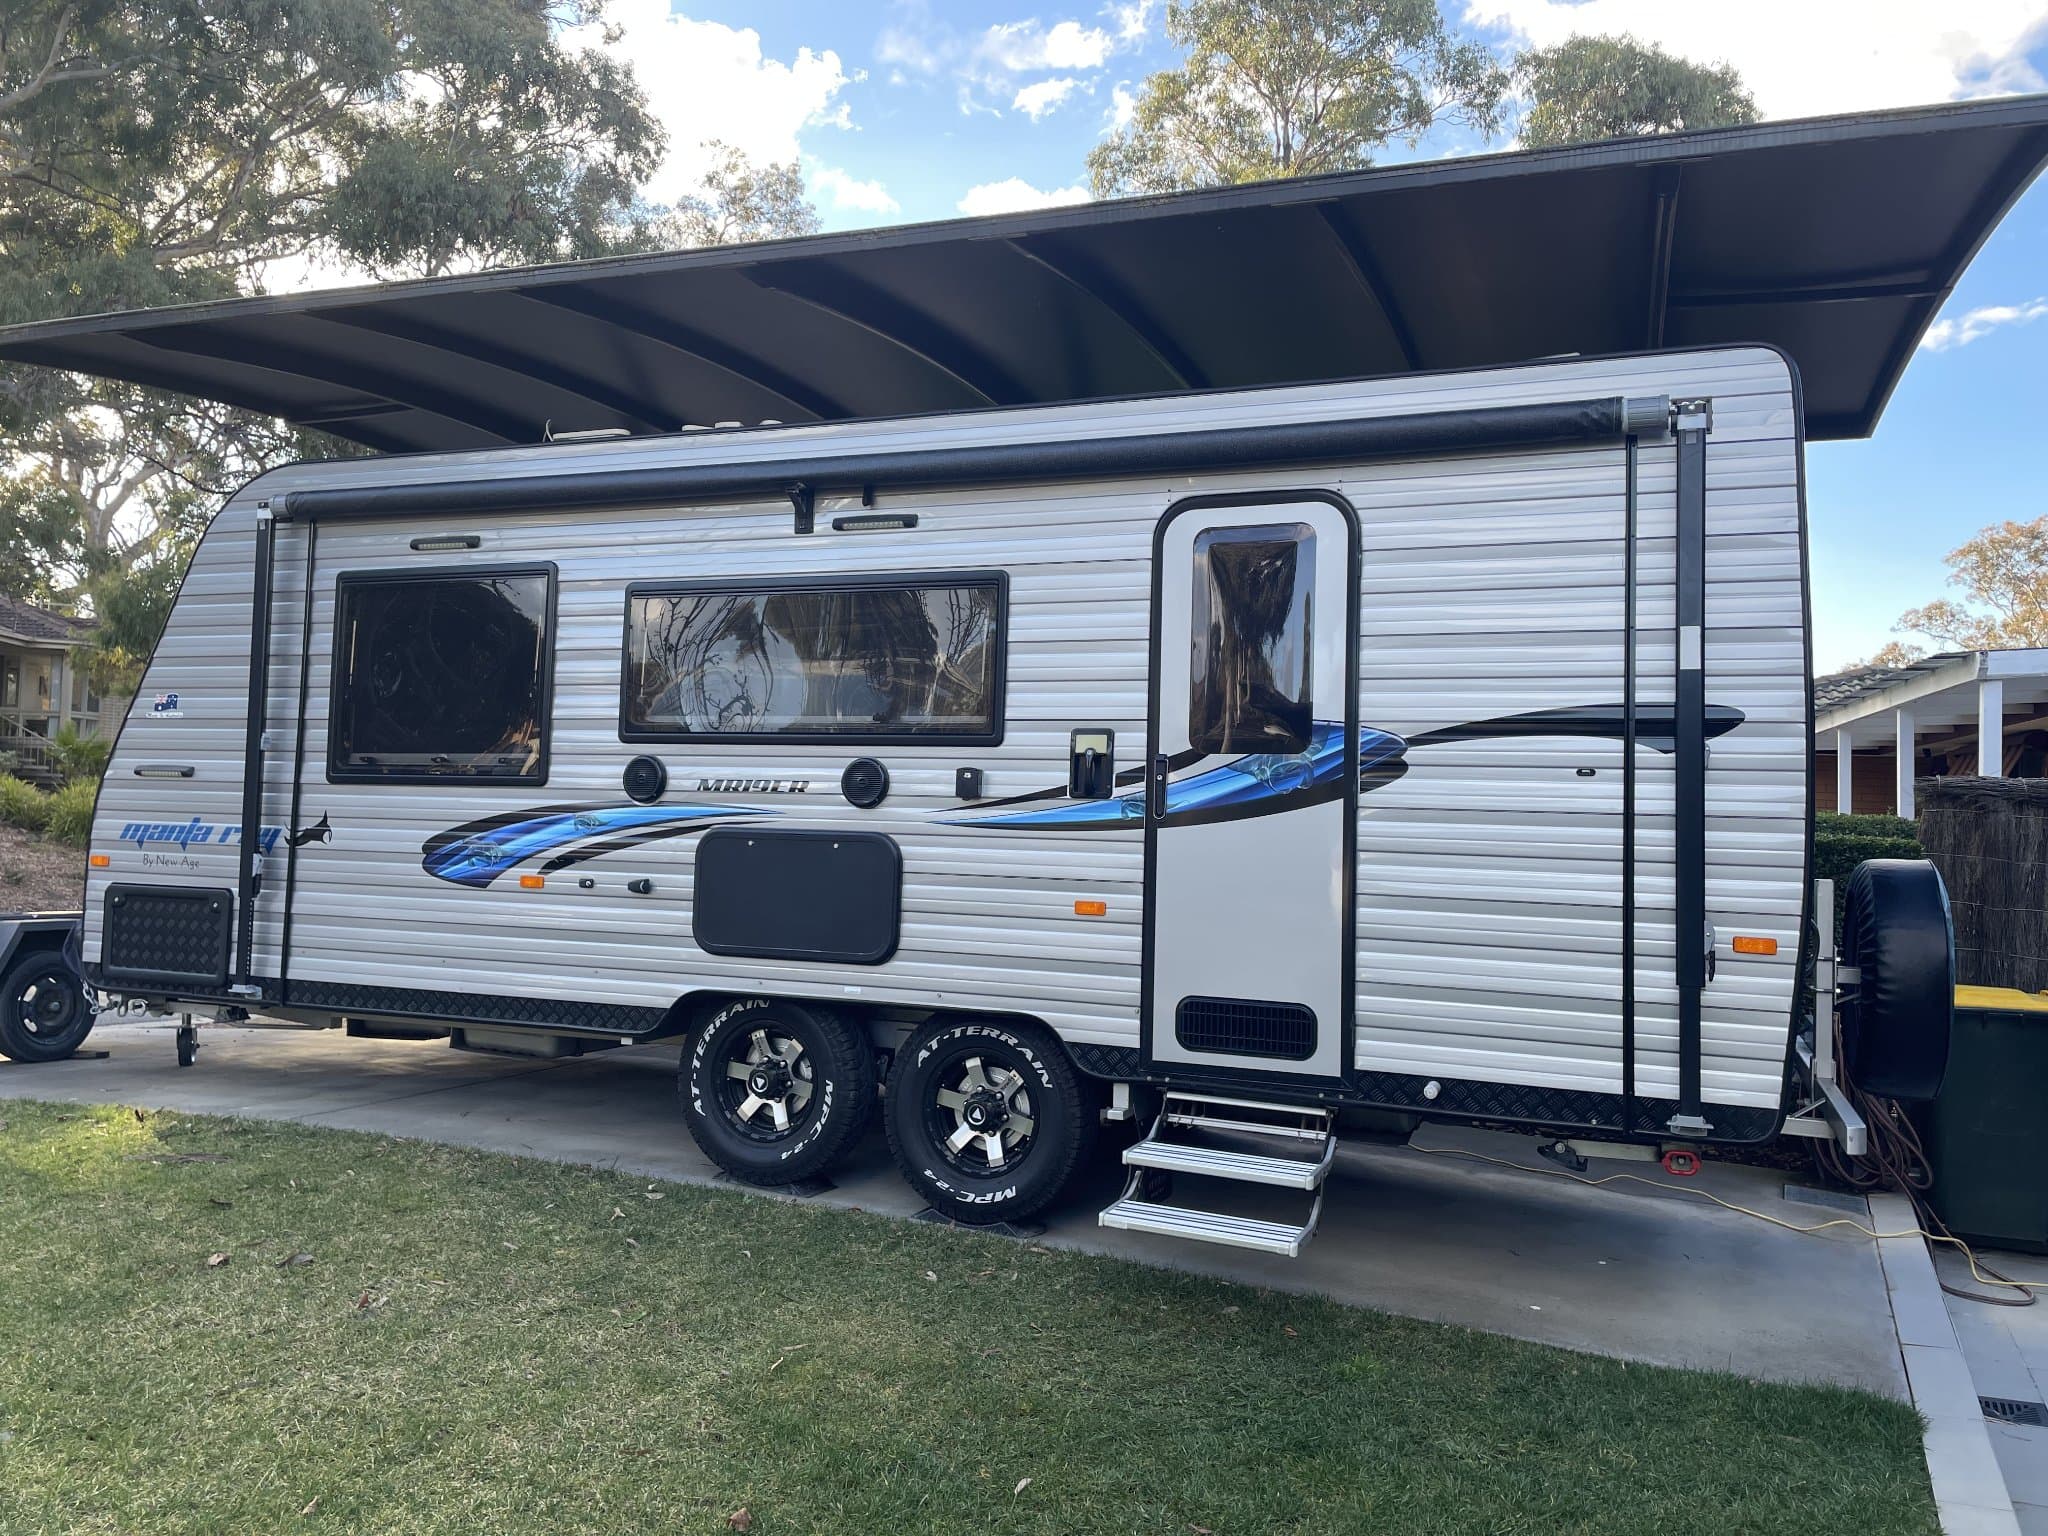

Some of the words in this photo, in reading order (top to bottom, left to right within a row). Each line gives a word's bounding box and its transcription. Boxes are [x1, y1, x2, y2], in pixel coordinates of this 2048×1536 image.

[119, 817, 215, 852] manta
[218, 826, 283, 855] ry
[142, 854, 153, 866] By
[156, 855, 178, 866] New
[180, 856, 200, 870] Age
[690, 999, 770, 1117] AT-TERRAIN
[918, 1025, 1053, 1089] AT-TERRAIN
